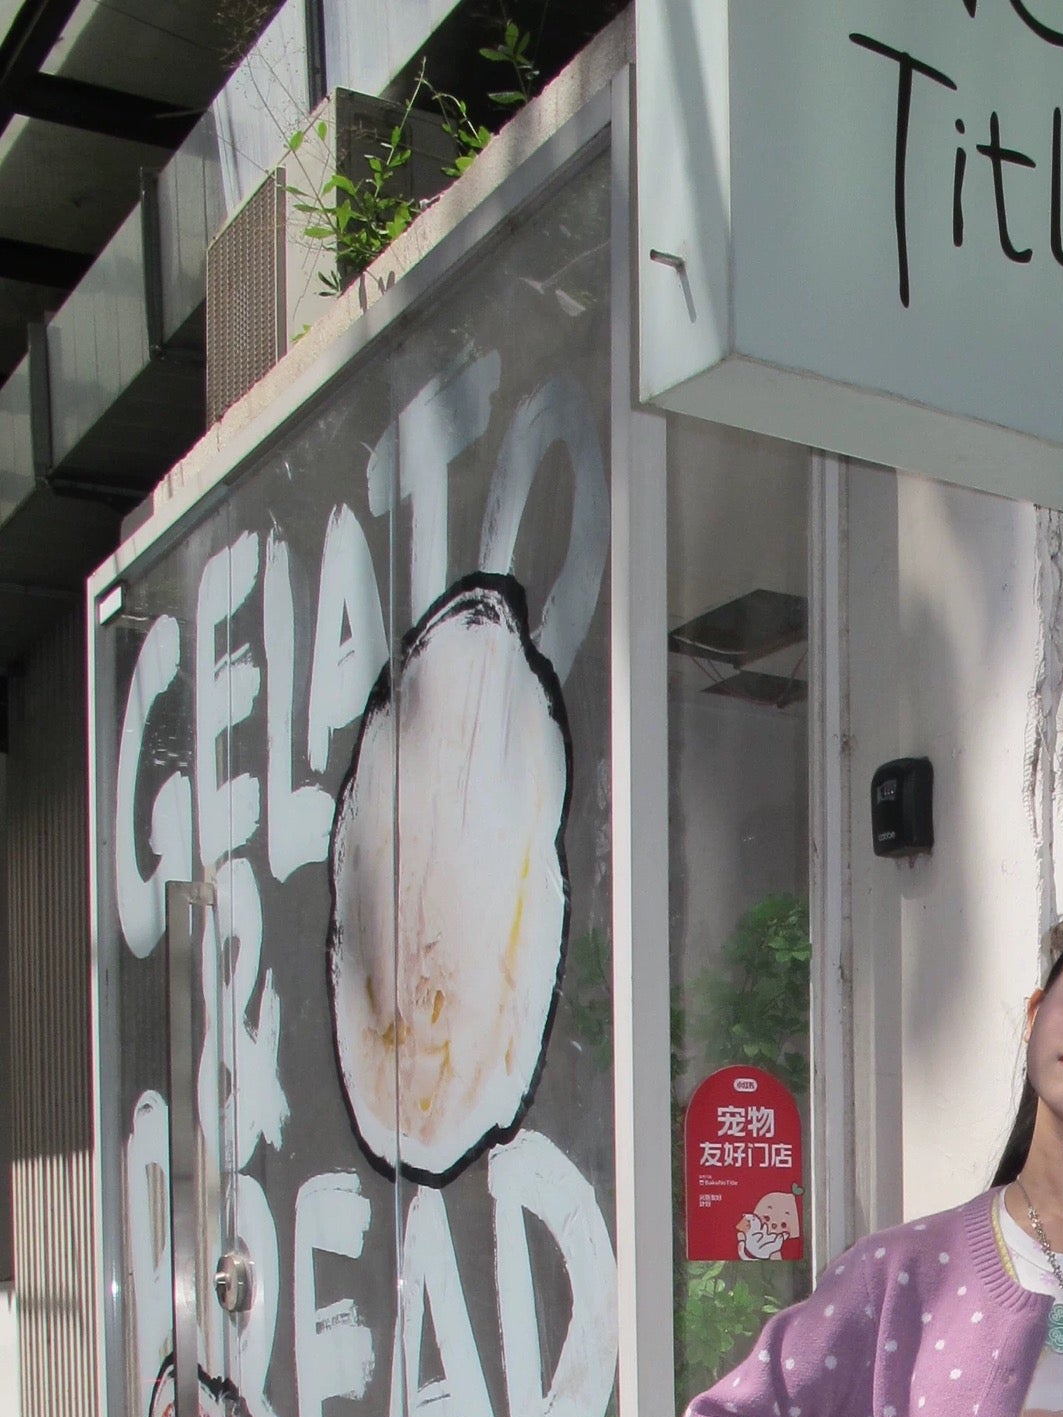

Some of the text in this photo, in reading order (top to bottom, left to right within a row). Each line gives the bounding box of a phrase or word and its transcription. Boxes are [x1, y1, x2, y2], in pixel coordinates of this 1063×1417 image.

[116, 348, 612, 960] GELATO
[717, 1105, 774, 1138] 宠物
[699, 1142, 793, 1168] 友好门店
